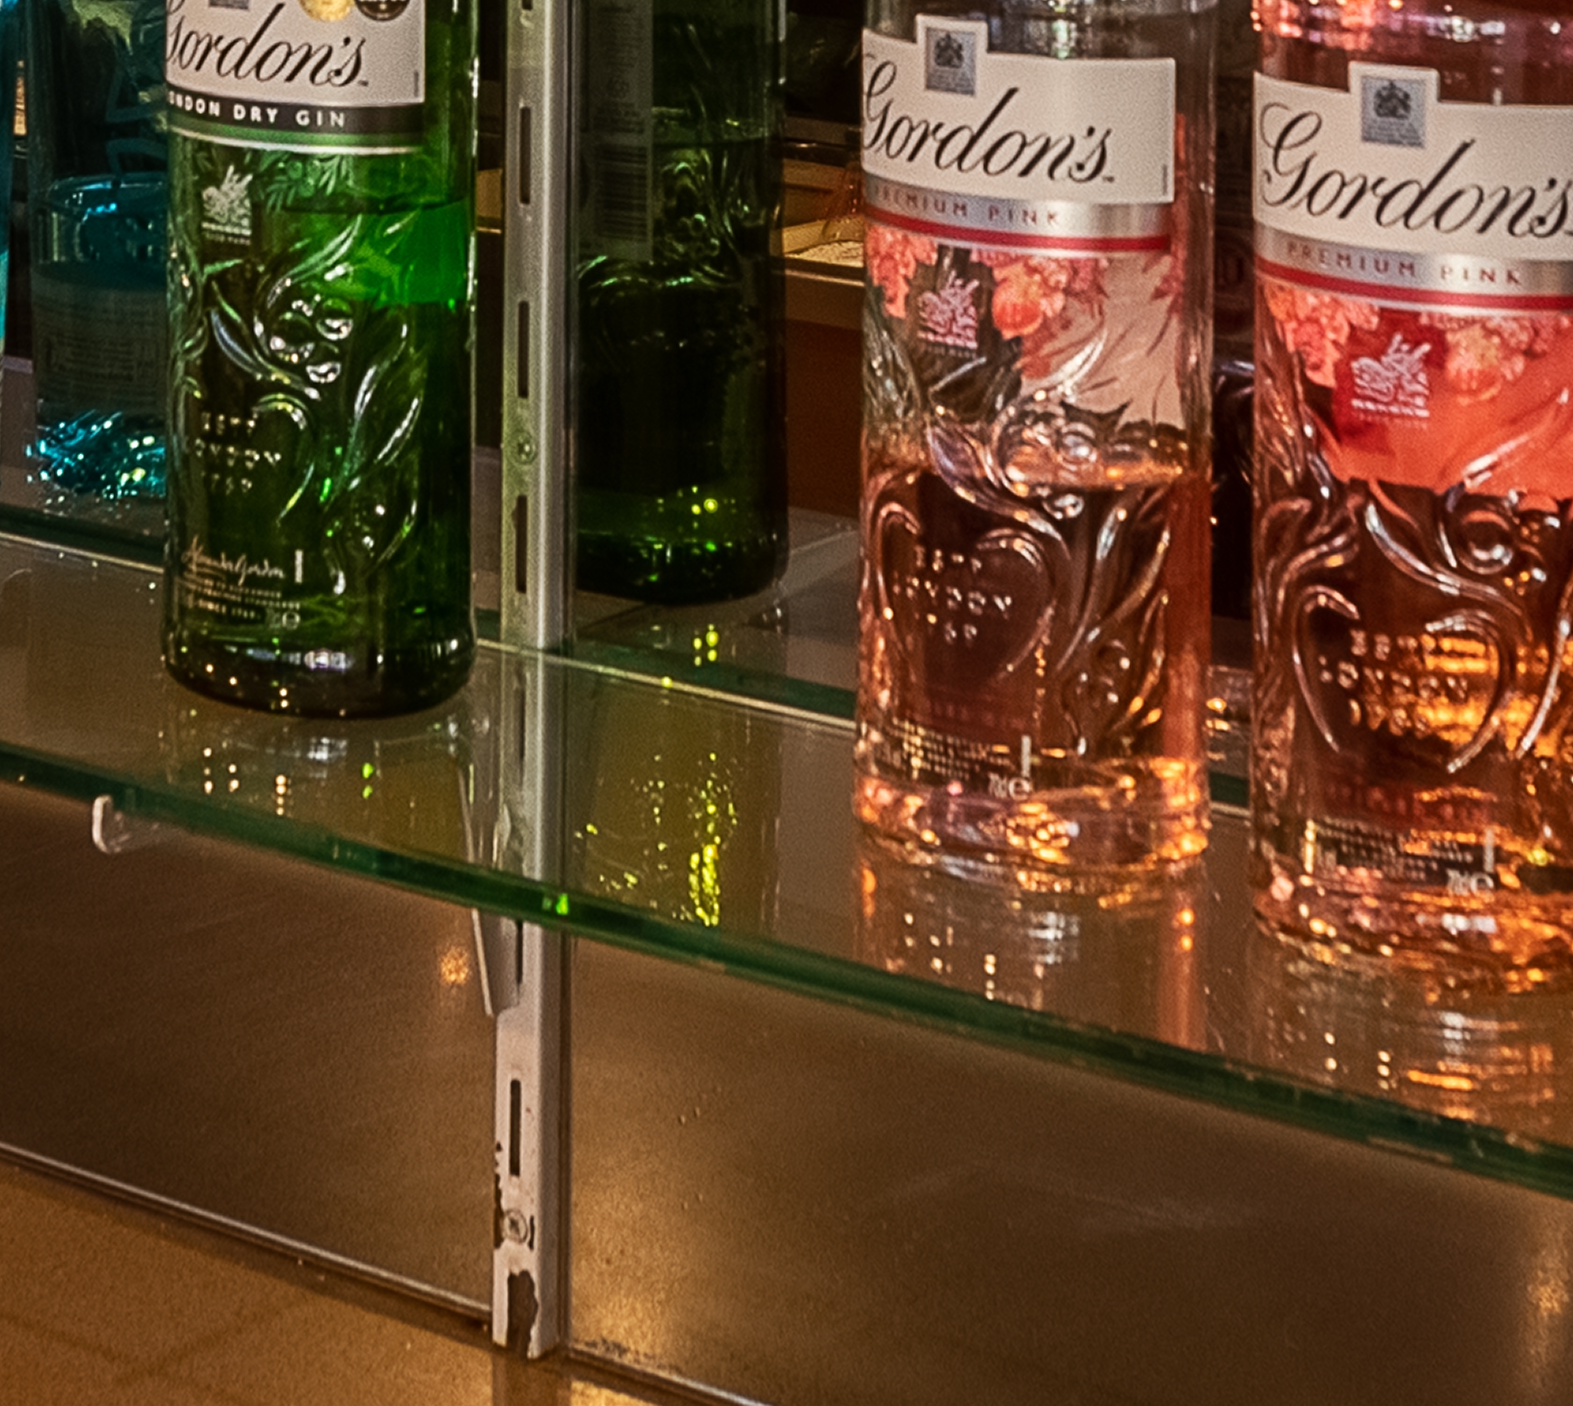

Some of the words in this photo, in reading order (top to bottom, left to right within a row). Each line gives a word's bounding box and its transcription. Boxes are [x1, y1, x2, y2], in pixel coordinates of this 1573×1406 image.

[232, 99, 278, 124] DRY
[296, 104, 347, 129] GIN
[862, 52, 1111, 185] Gordon's
[988, 199, 1060, 226] PINK
[1286, 241, 1418, 278] PREMIUM
[1440, 265, 1523, 286] PINK
